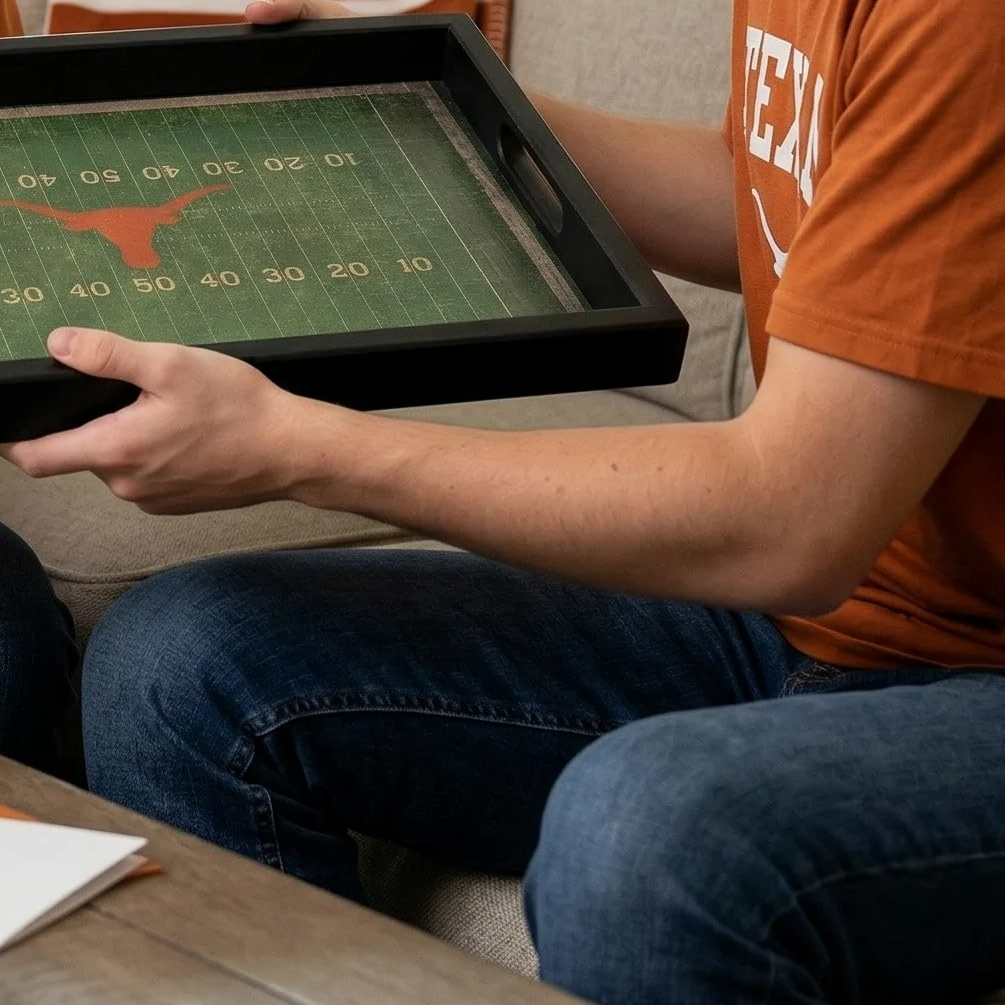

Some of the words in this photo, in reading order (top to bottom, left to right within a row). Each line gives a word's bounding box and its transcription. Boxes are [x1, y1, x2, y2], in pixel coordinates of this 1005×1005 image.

[17, 174, 57, 188] 40
[80, 169, 121, 184] 50
[142, 165, 180, 180] 40
[202, 161, 244, 176] 30
[263, 156, 305, 171] 20
[323, 152, 359, 167] 10
[0, 286, 44, 305] 30
[69, 281, 111, 298] 40
[133, 276, 176, 293] 50
[200, 270, 241, 288] 40
[262, 266, 305, 283] 30
[327, 261, 370, 278] 20
[396, 256, 433, 273] 10
